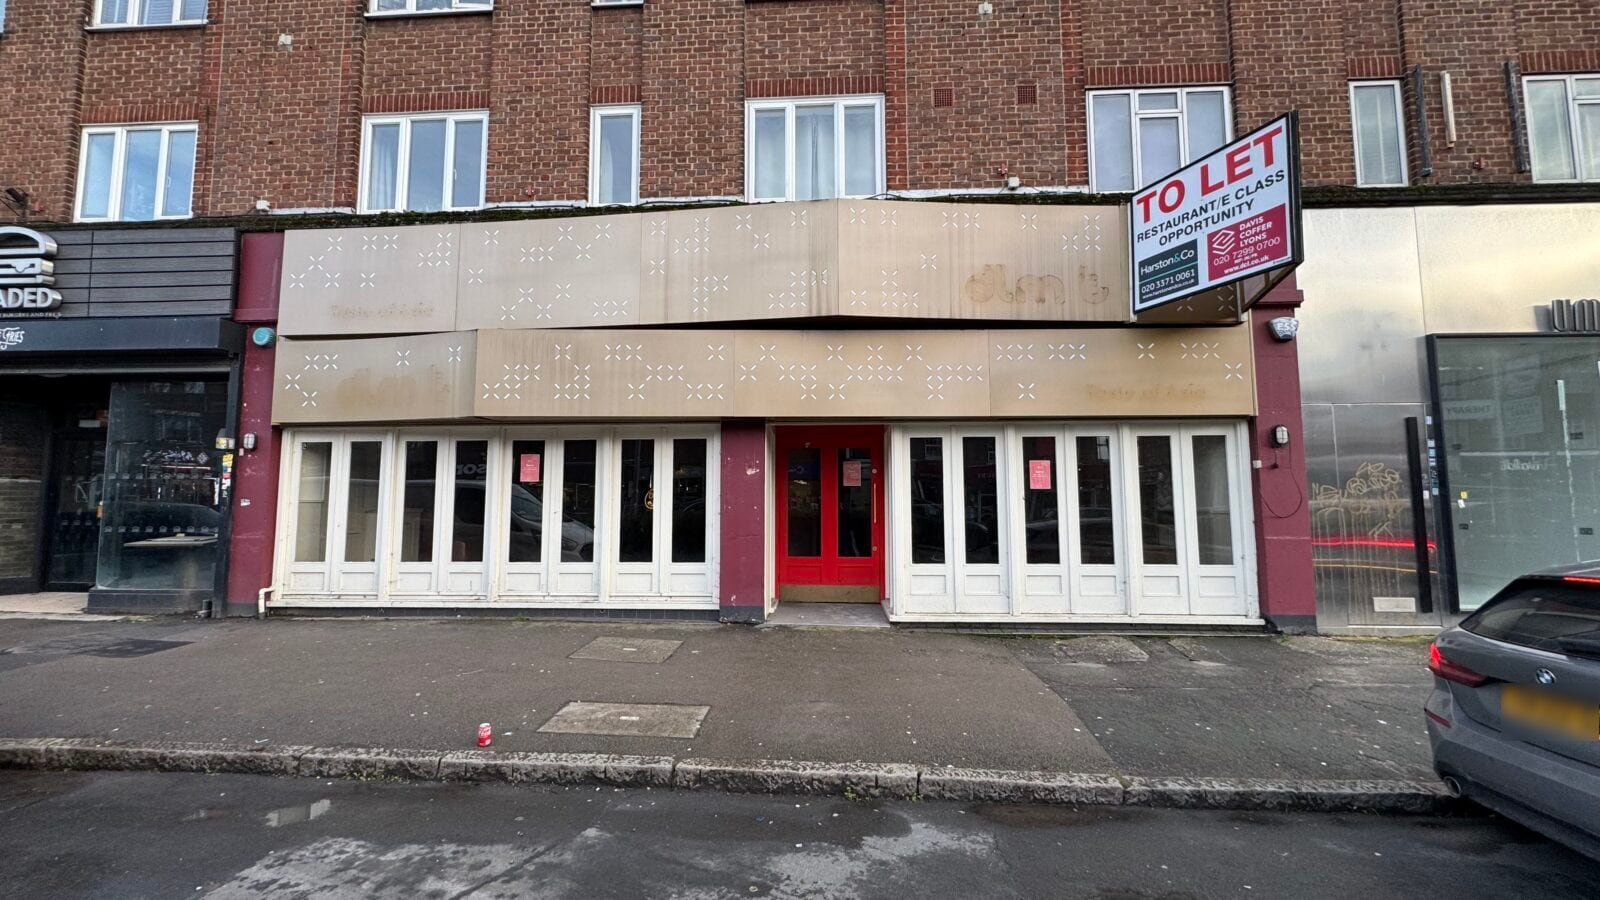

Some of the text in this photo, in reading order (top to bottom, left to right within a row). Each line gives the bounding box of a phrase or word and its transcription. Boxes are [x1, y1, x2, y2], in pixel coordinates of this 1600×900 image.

[1136, 125, 1283, 224] TO LET
[1137, 169, 1285, 243] RESTAURANT/E CLASS
[1159, 198, 1254, 246] OPPORTUNITY
[1239, 215, 1264, 231] DAVIS
[1239, 221, 1273, 239] COFFER
[1213, 254, 1230, 266] 020
[1232, 246, 1255, 259] 7299
[1256, 236, 1281, 251] 0700
[1239, 232, 1268, 247] LYONS
[1140, 249, 1195, 276] Harston&Co
[1141, 269, 1195, 294] 020 3371 0061
